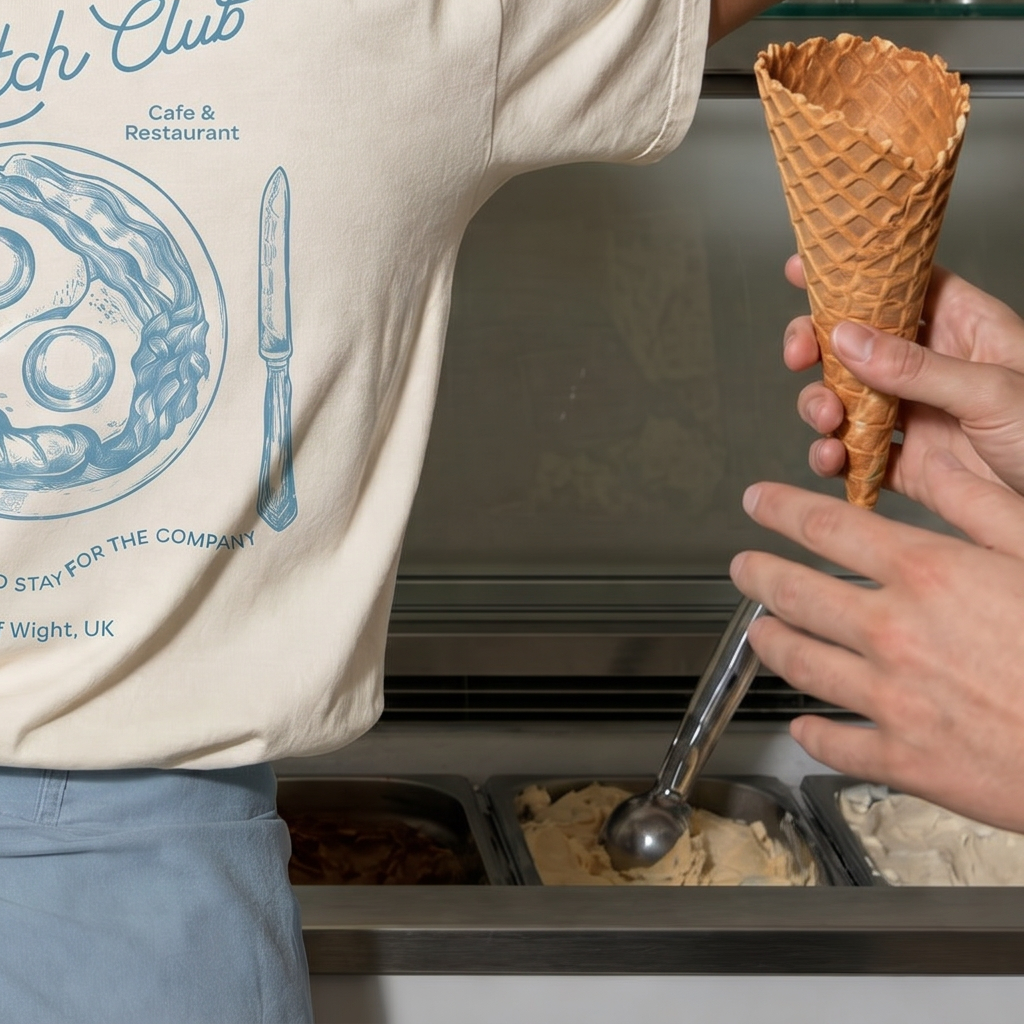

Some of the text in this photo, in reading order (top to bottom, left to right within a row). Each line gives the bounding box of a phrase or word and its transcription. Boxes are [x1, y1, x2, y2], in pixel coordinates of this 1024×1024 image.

[147, 103, 216, 122] Cafe &
[124, 123, 240, 142] Restaurant
[14, 570, 63, 593] STAY
[64, 545, 106, 579] FOR
[106, 528, 150, 553] THE
[155, 527, 256, 549] COMPANY
[9, 621, 79, 644] Wight,
[83, 619, 115, 638] UK
